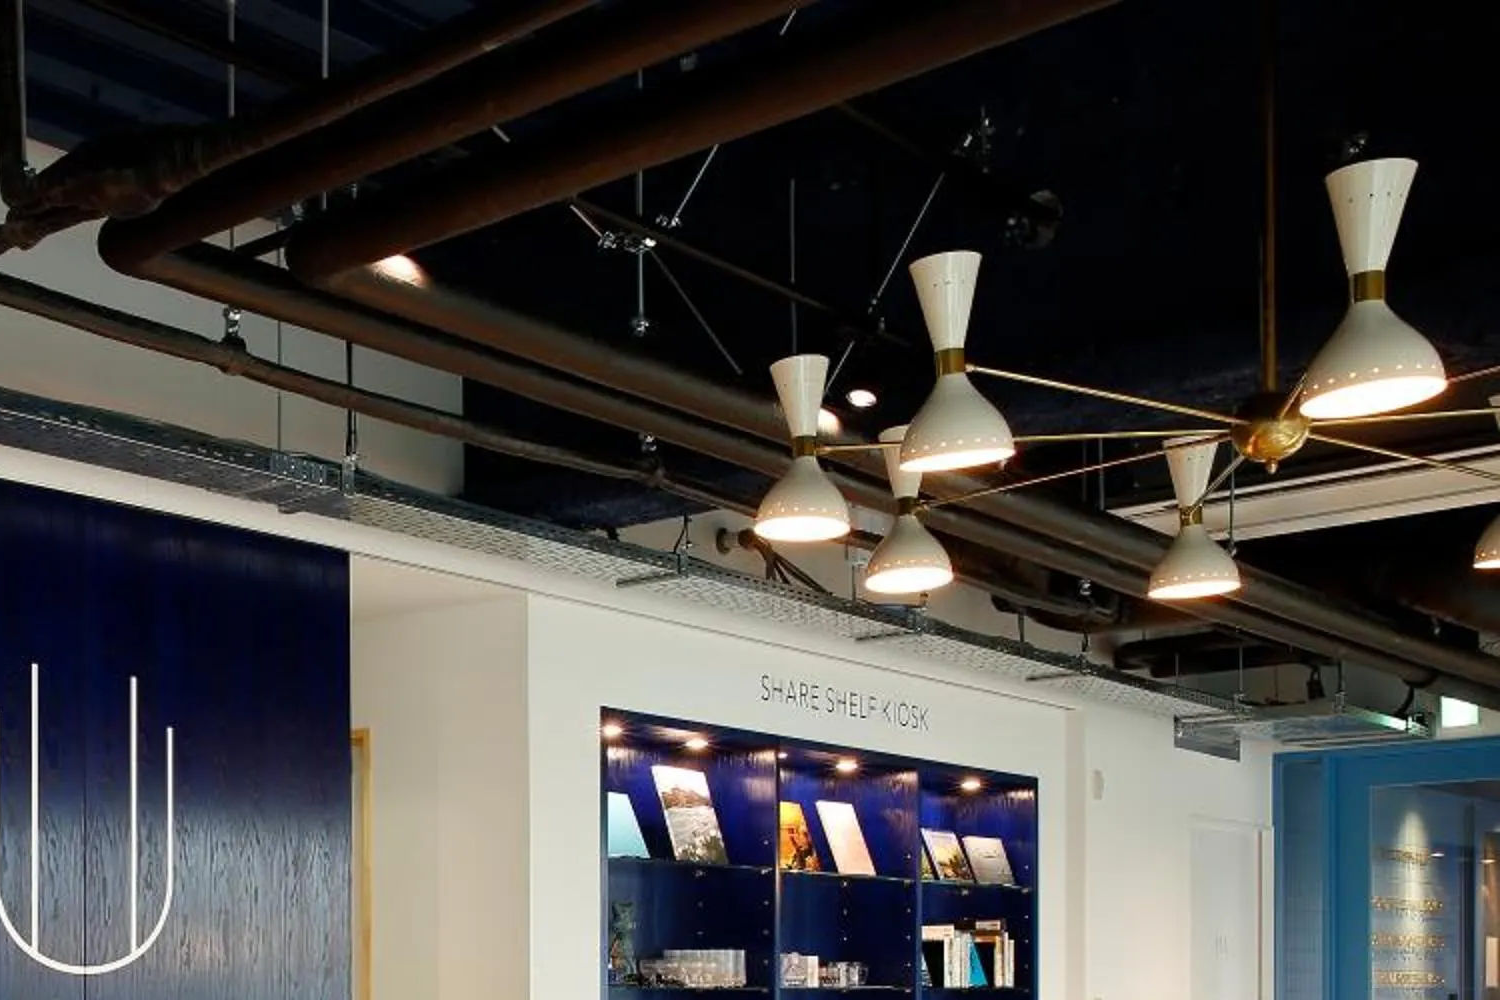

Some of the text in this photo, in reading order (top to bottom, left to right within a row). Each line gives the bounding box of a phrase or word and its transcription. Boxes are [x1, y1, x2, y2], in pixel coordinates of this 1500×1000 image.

[760, 674, 930, 731] SHARE SHELF KIOSK
